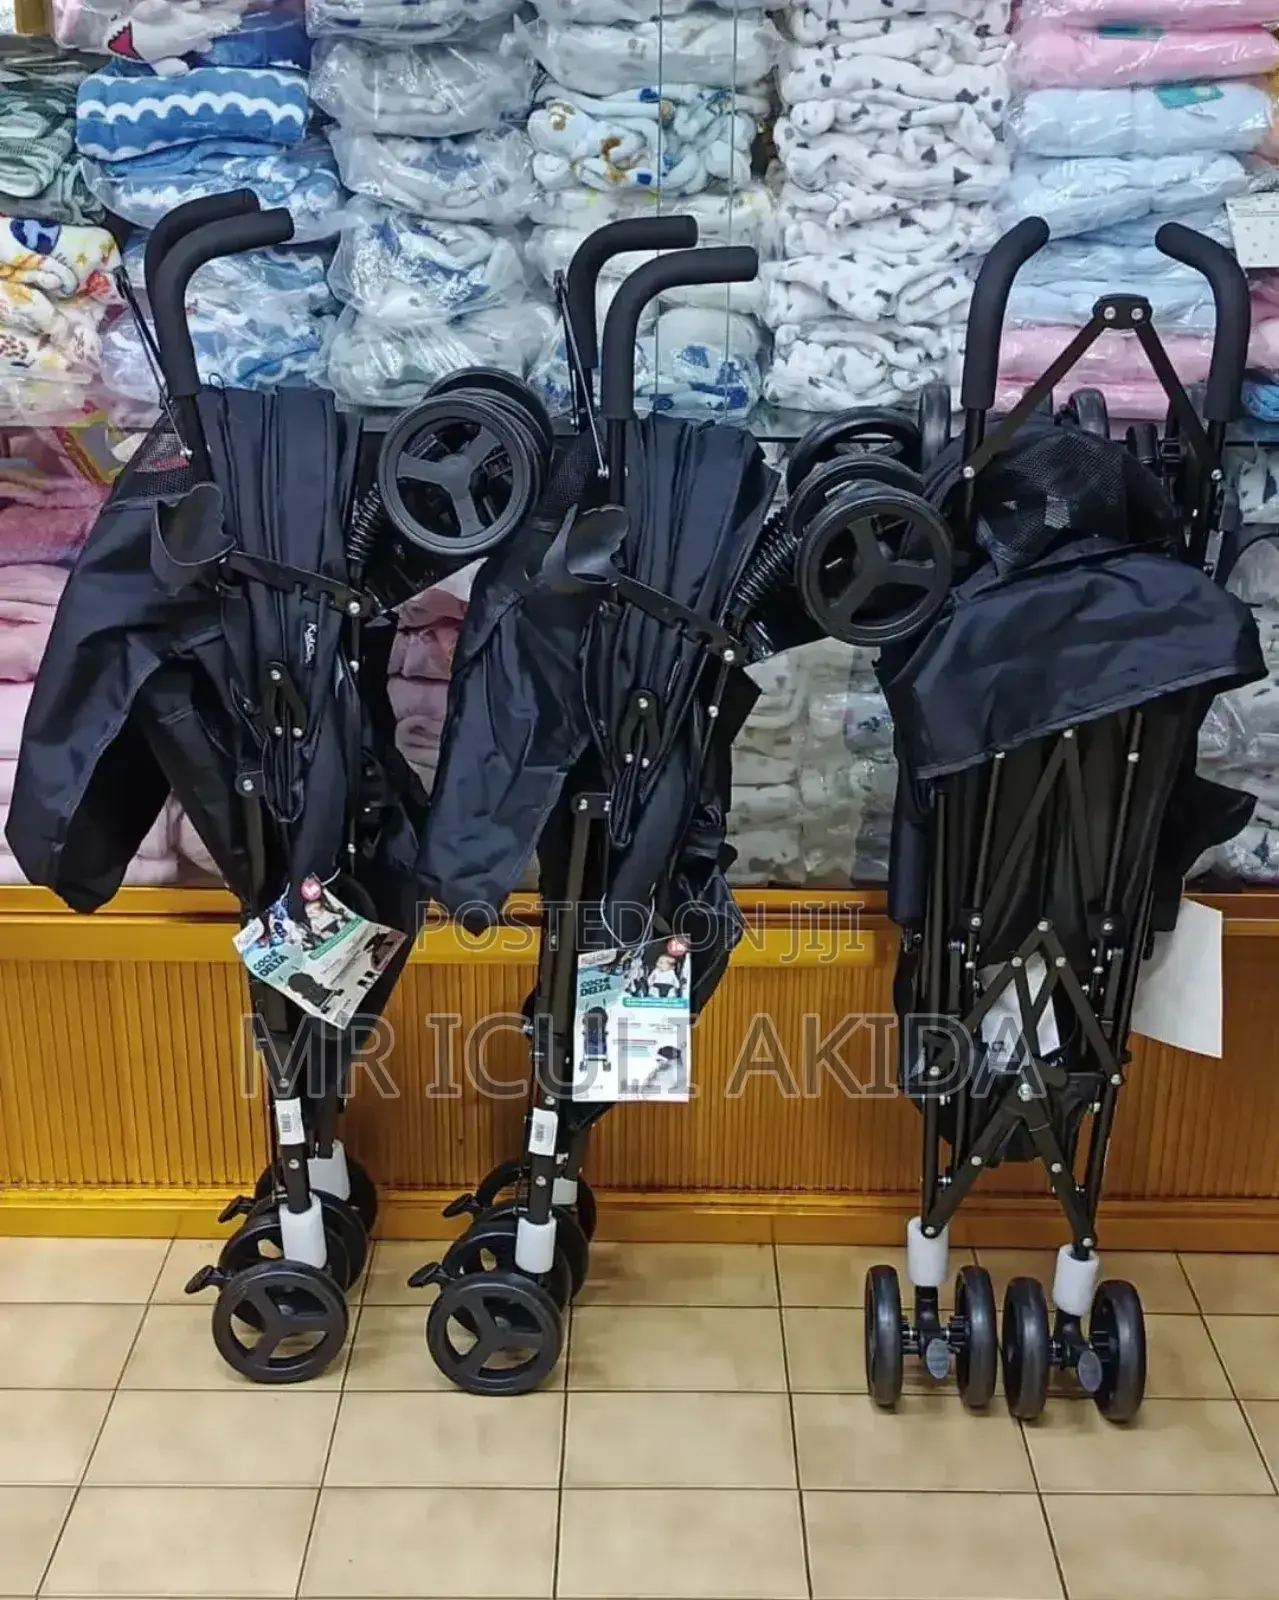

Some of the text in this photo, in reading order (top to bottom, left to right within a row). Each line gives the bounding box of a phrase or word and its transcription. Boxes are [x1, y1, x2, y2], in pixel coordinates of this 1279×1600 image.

[253, 948, 279, 972] COCHE
[259, 954, 290, 978] DELTA
[580, 984, 612, 997] DELTA
